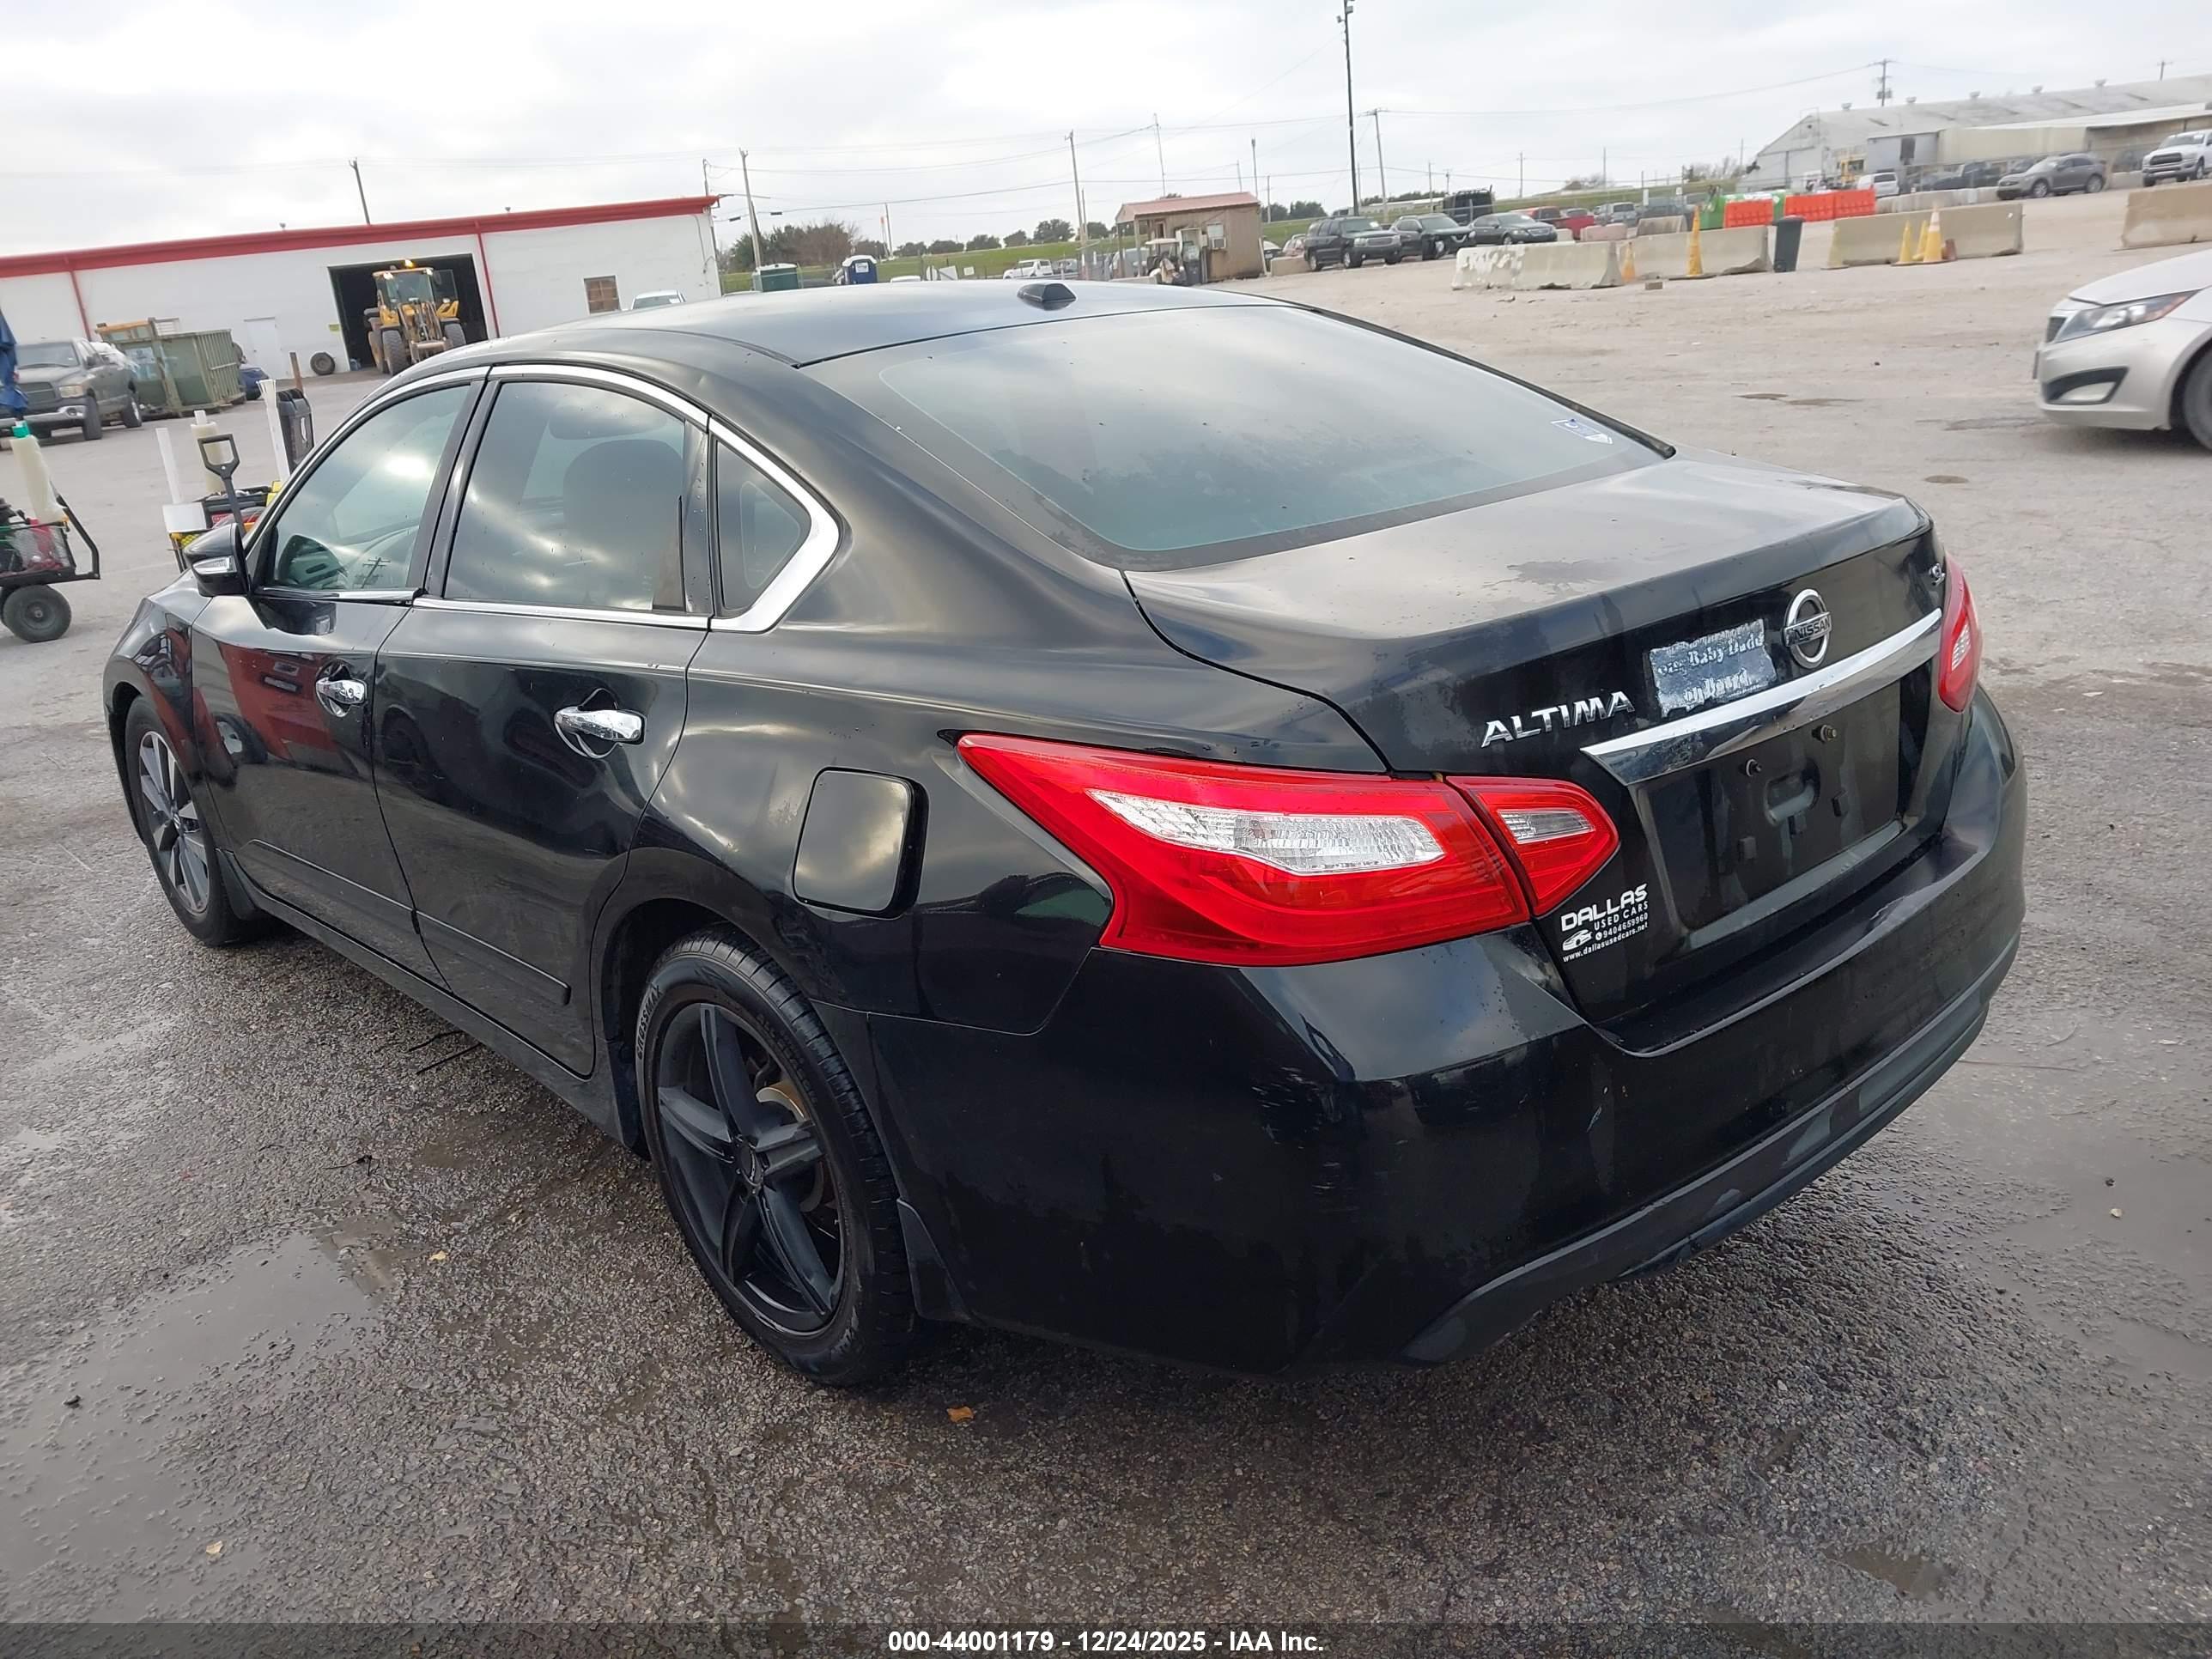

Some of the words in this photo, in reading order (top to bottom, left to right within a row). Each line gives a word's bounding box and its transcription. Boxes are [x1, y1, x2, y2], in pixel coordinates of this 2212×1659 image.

[1794, 613, 1832, 641] NISSAN
[1481, 690, 1635, 748] ALTIMA
[1561, 883, 1647, 932] DALLAS
[1594, 914, 1620, 931] USED
[1623, 901, 1648, 919] CARS
[1563, 921, 1648, 963] www.dallasusedcars.net
